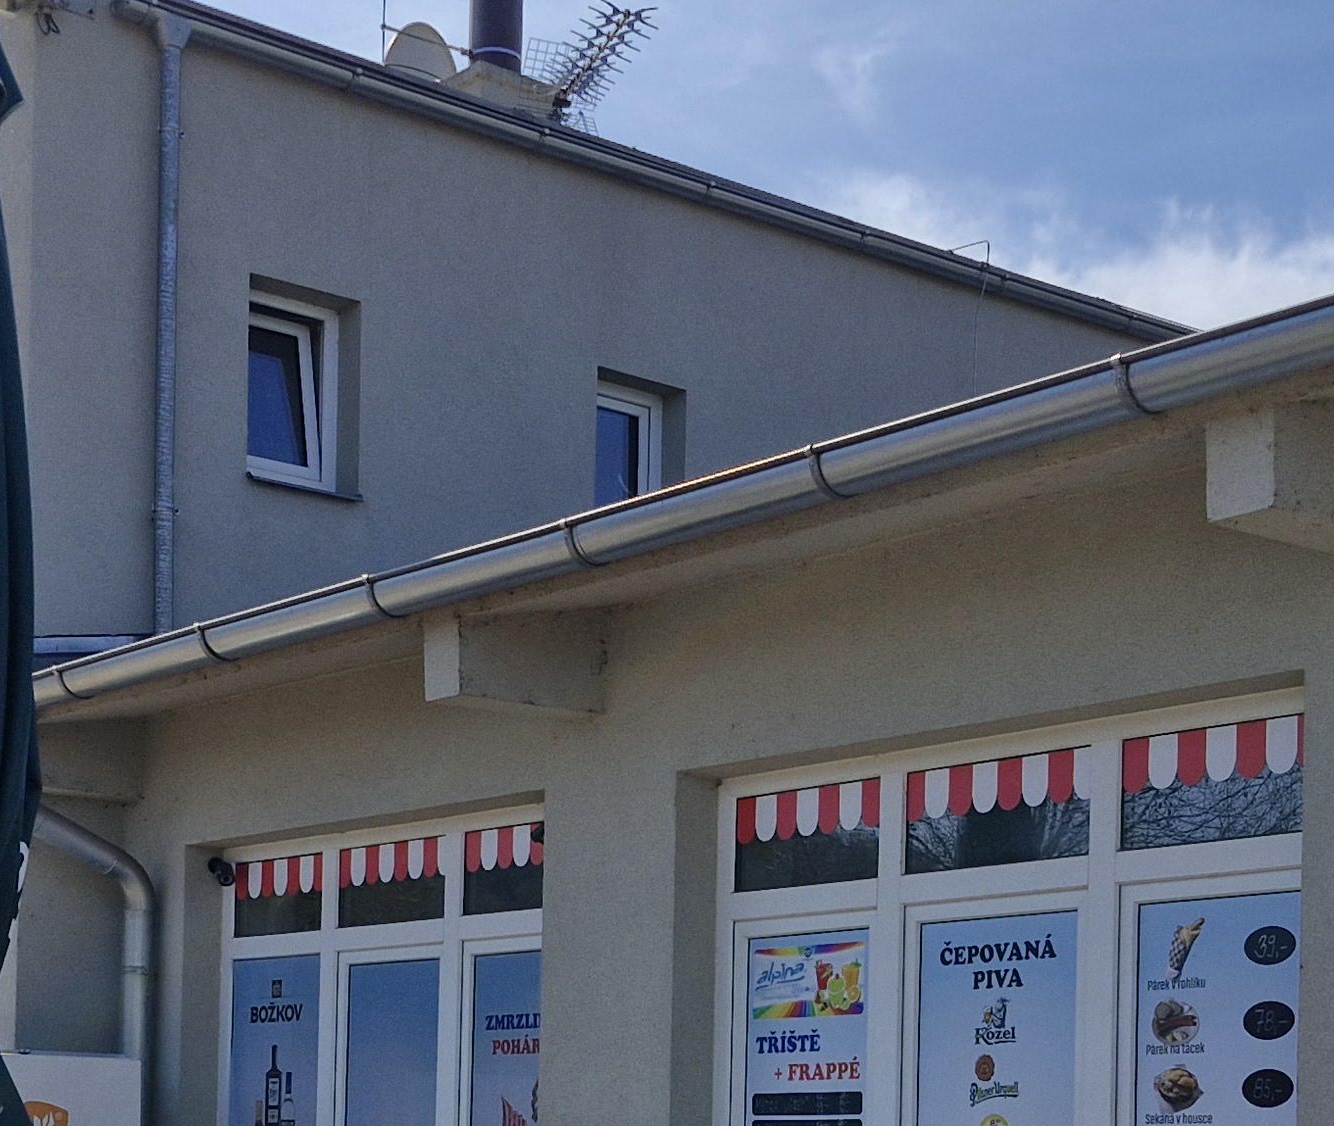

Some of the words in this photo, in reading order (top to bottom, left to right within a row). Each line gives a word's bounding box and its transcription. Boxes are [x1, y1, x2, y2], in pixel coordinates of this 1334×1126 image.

[940, 934, 1057, 966] ČEPOVANÁ
[757, 961, 805, 985] alpina
[973, 968, 1024, 990] PIVA
[250, 1002, 303, 1023] BOŽKOV
[755, 1029, 821, 1054] TŘÍŠTĚ
[975, 1026, 1016, 1046] Kozel
[787, 1056, 861, 1081] FRAPPÉ
